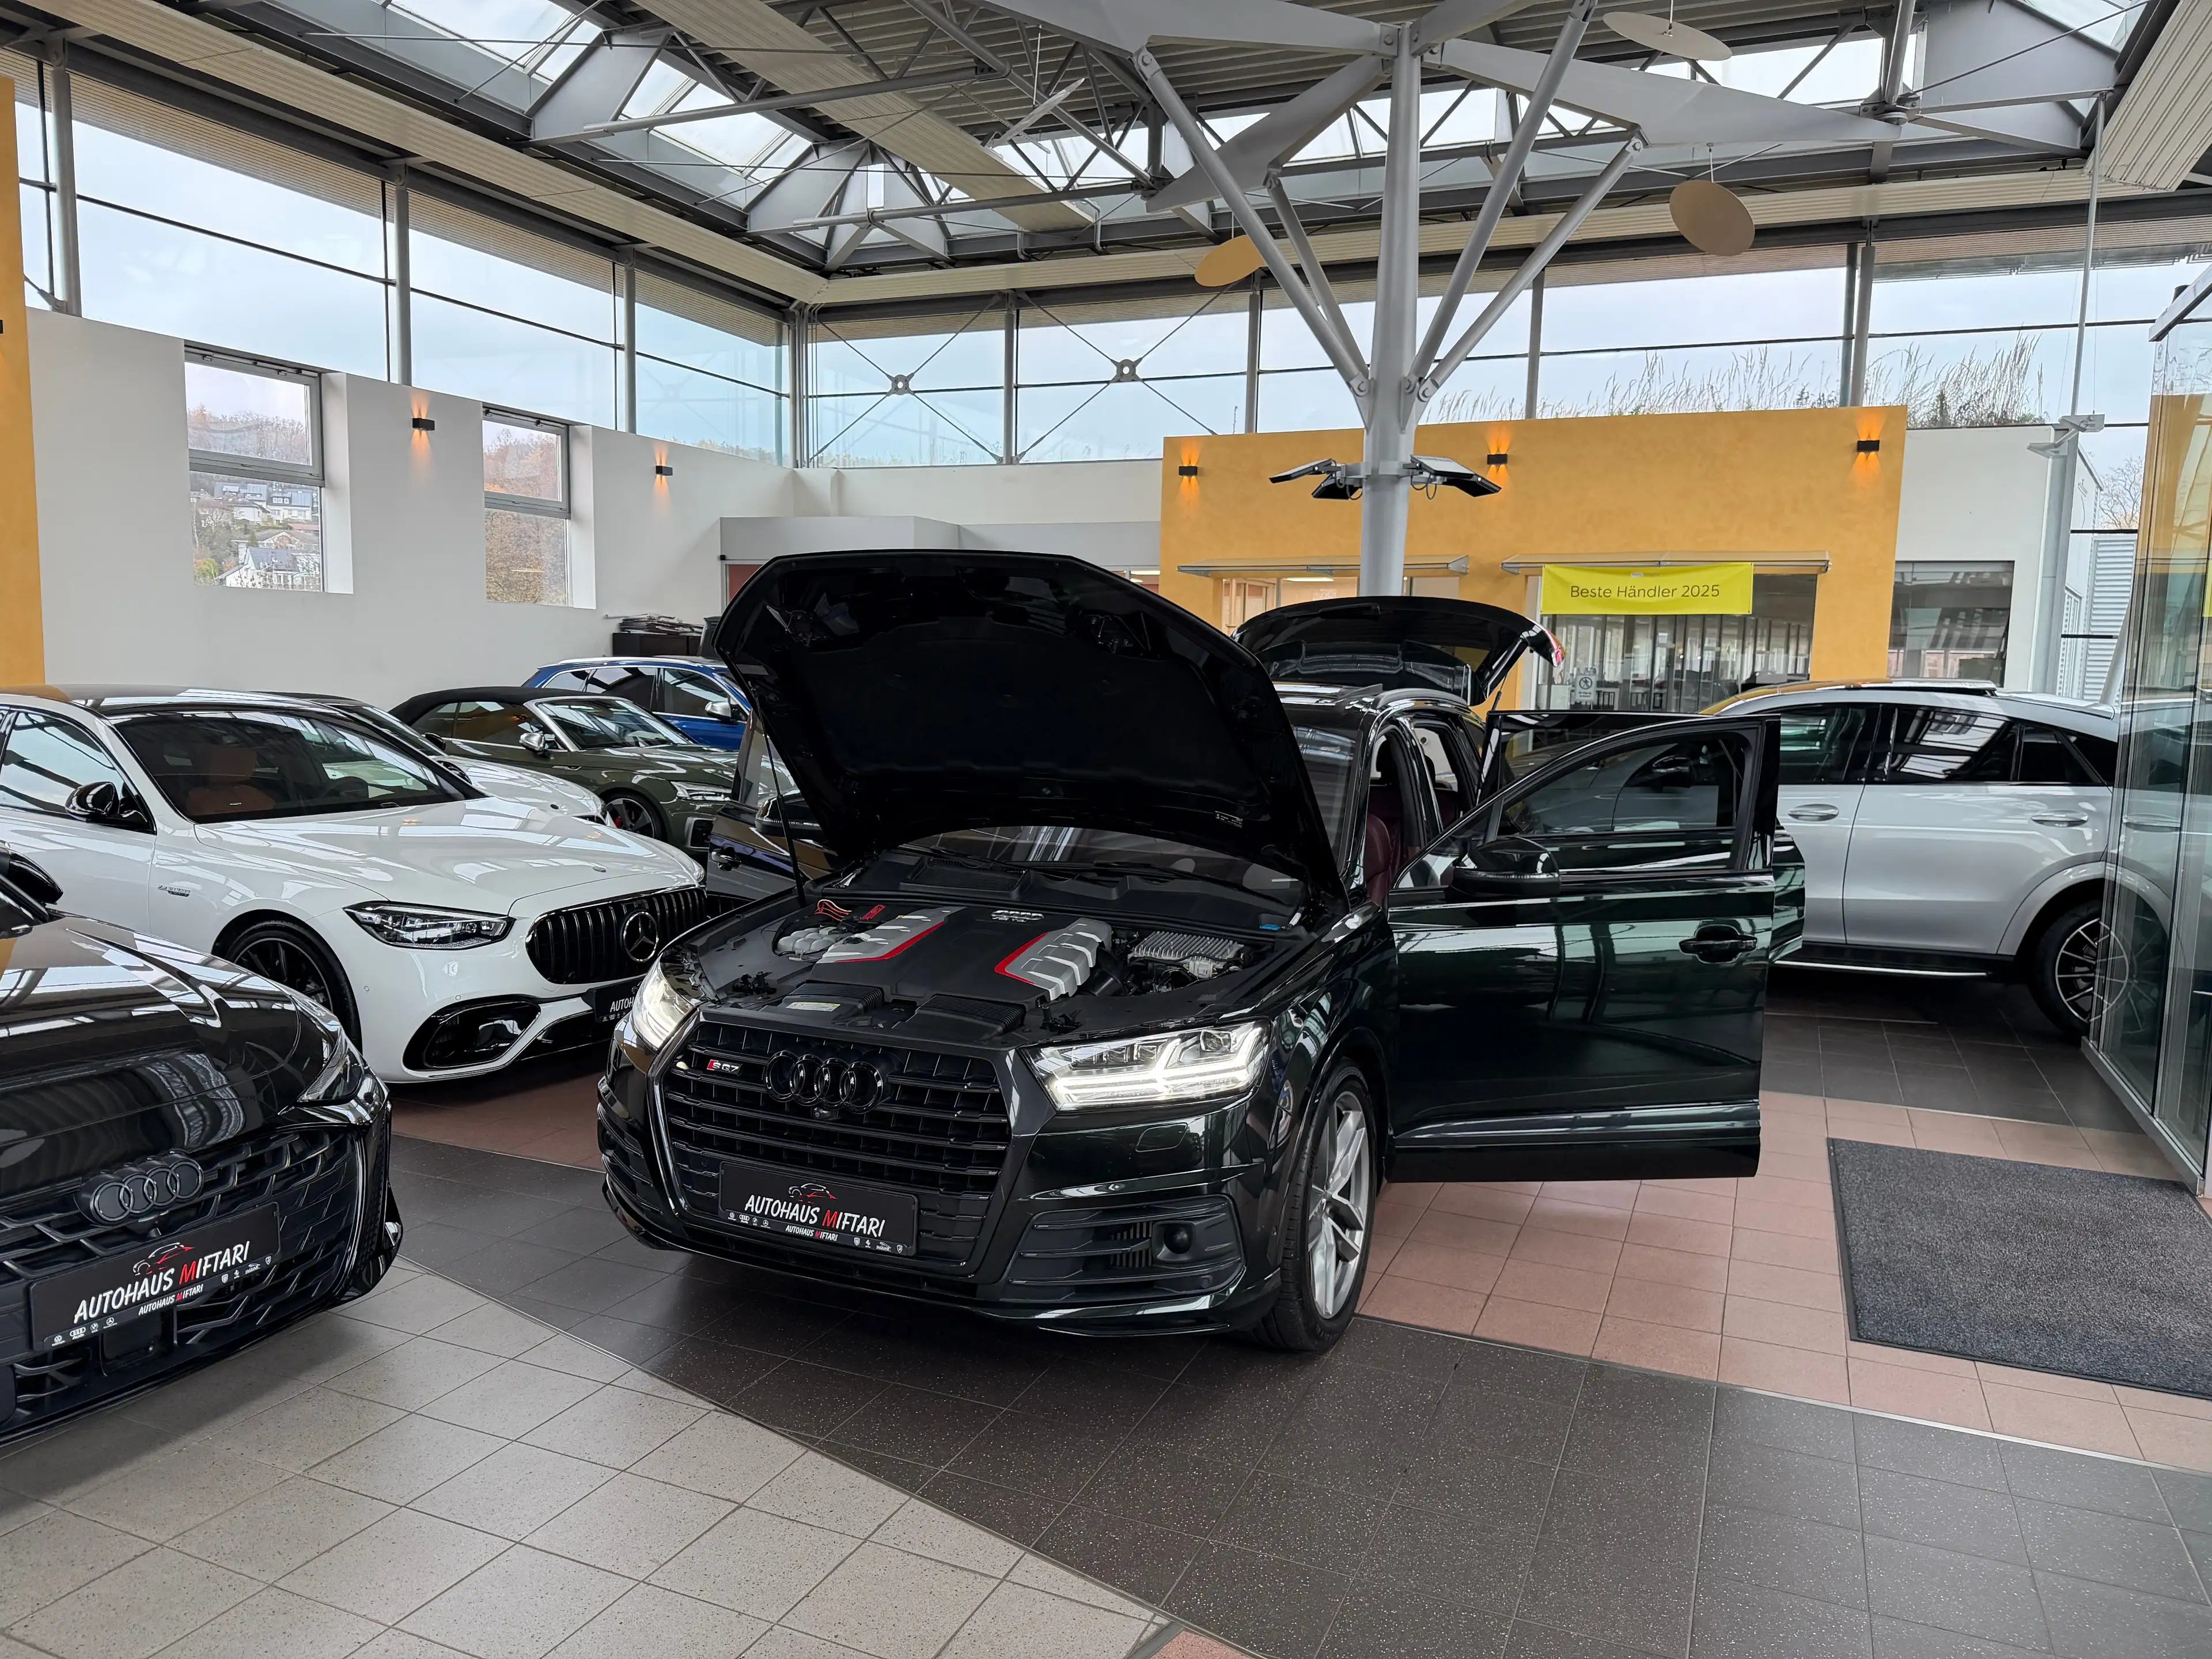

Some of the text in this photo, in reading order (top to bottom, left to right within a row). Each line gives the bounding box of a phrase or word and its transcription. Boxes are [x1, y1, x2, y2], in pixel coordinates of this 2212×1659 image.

[1570, 584, 1720, 598] Beste Händler 2025
[710, 1062, 740, 1073] SQ7
[744, 1194, 885, 1237] AUTOHAUS MIFTARI
[785, 1225, 838, 1241] AUTOHAUS MIFTARI
[74, 1241, 250, 1324] AUTOHAUS MIFTARI
[138, 1283, 204, 1316] AUTOHAUS MIFTARI
